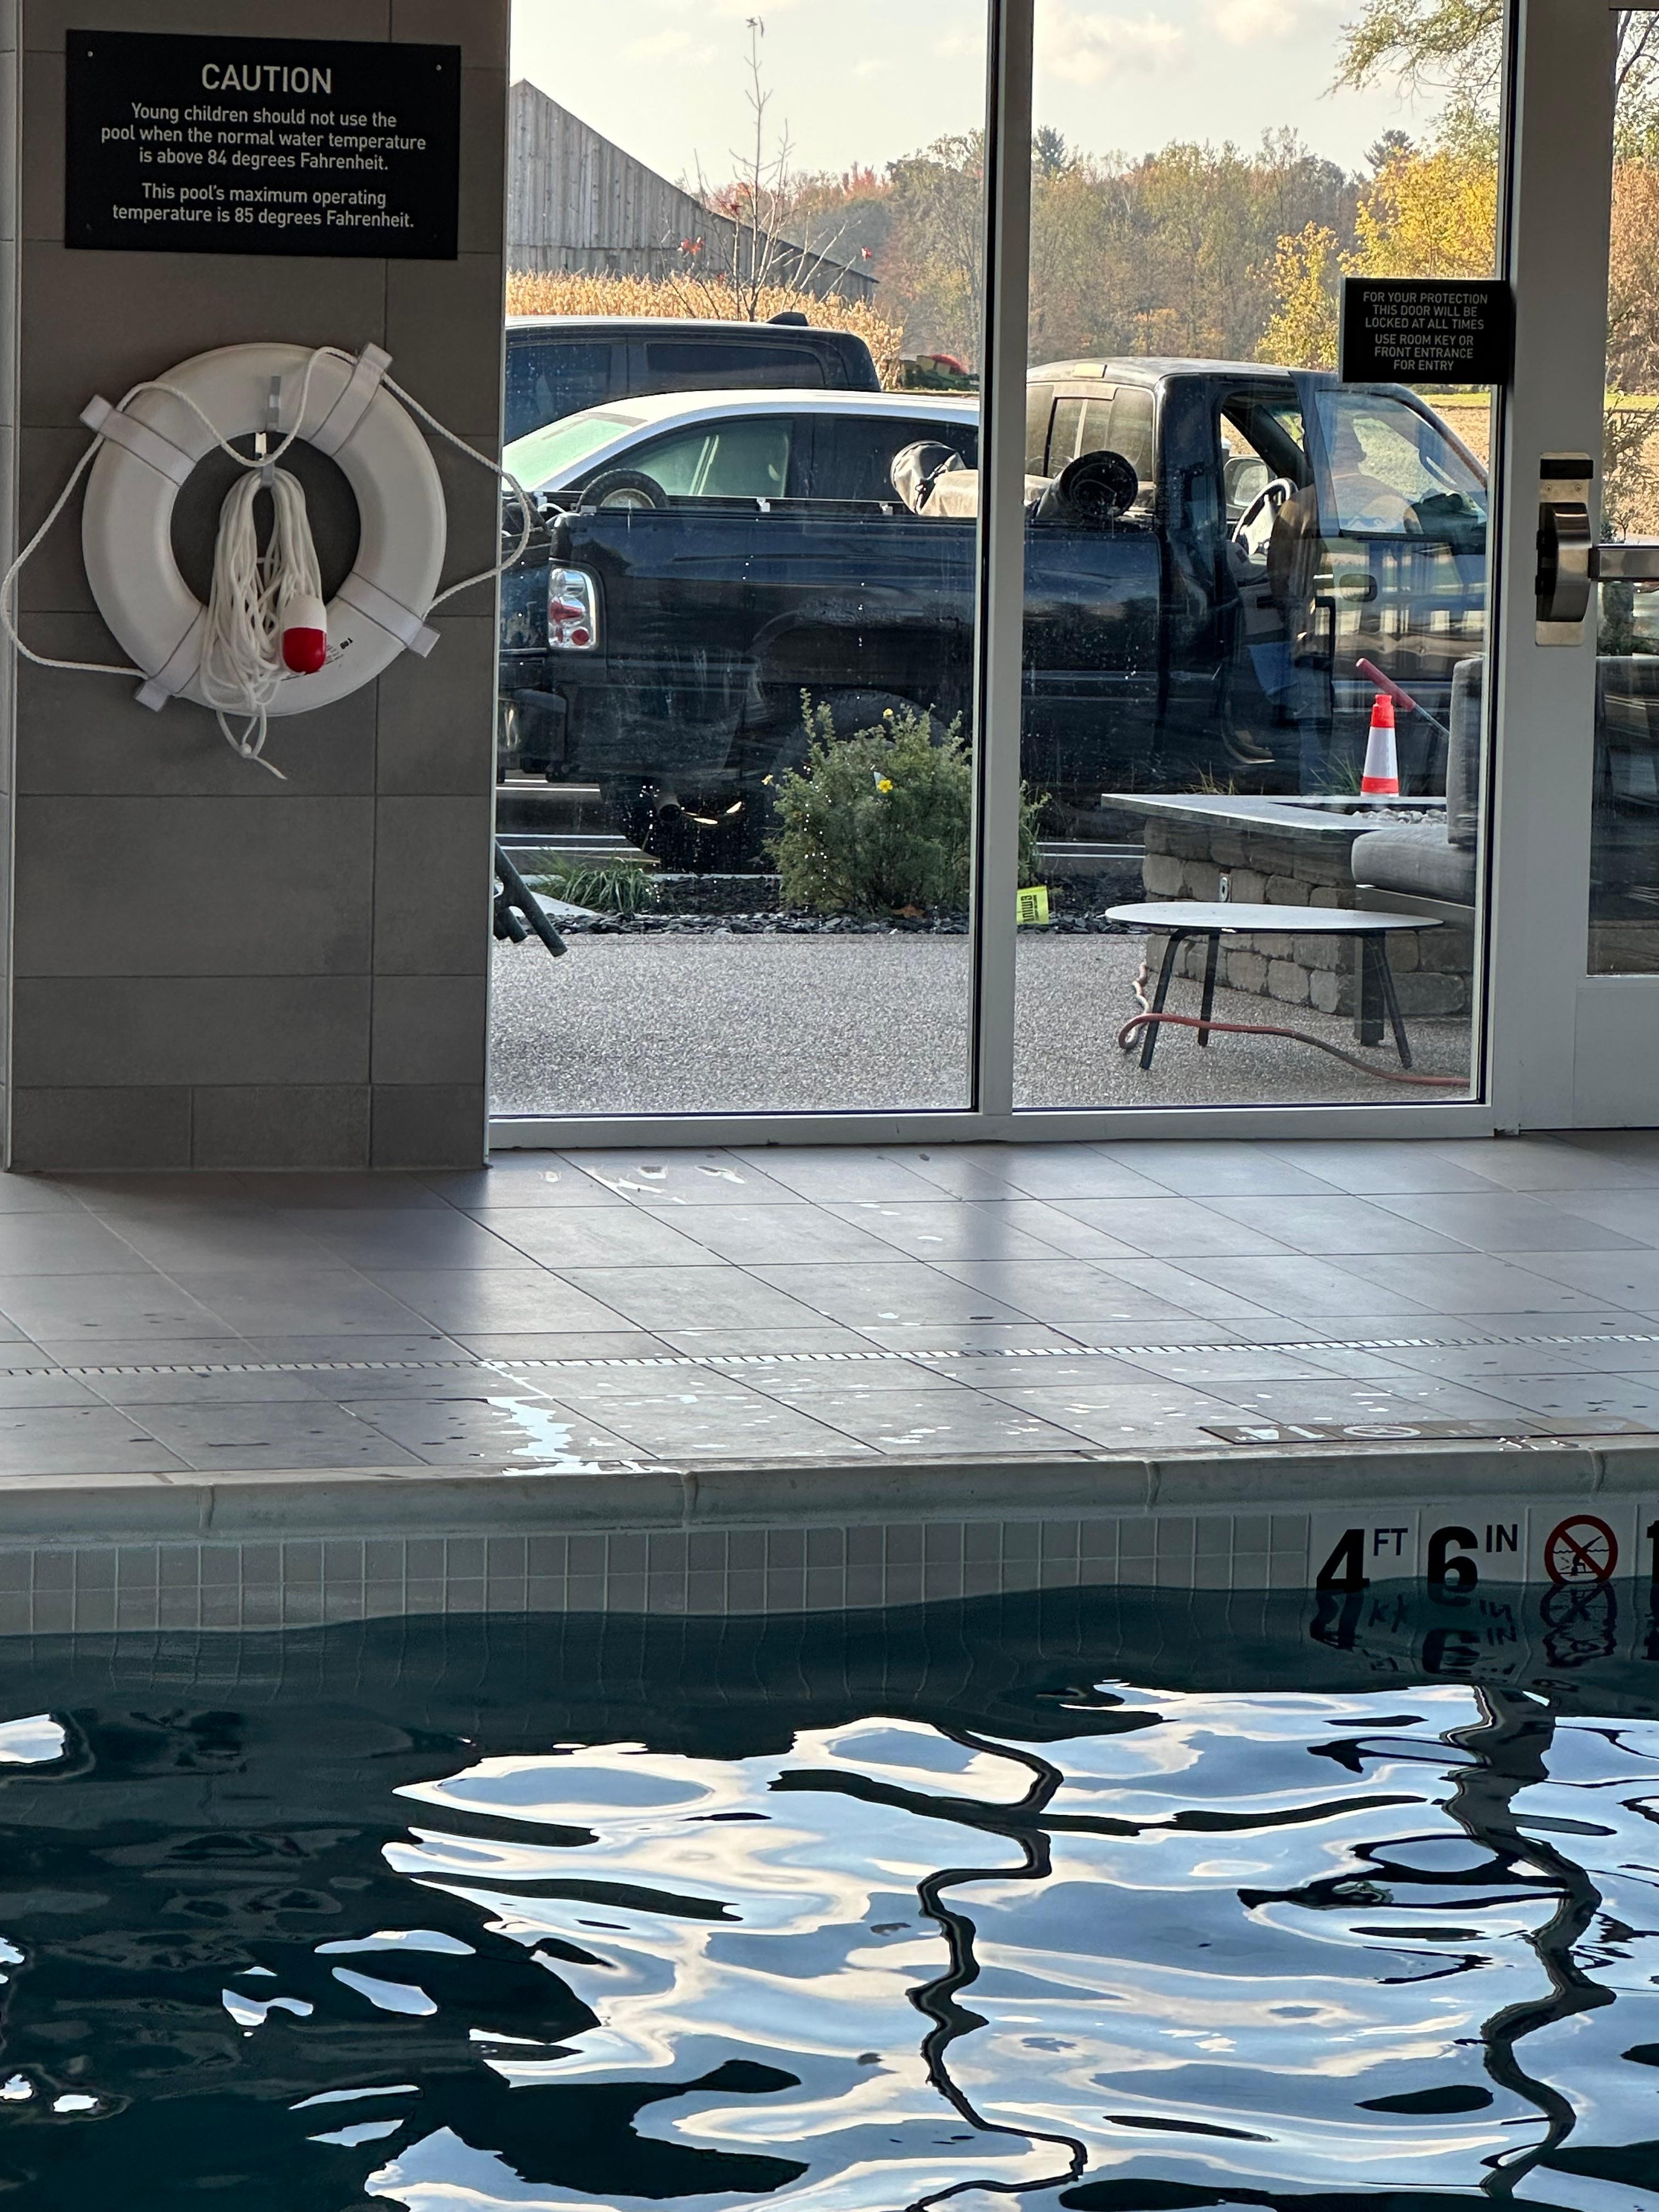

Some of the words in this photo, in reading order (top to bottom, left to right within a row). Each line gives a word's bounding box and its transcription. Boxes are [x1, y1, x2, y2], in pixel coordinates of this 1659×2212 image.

[201, 63, 331, 94] CAUTION
[131, 101, 179, 125] Young
[184, 104, 249, 123] children
[252, 107, 306, 125] should
[310, 111, 335, 126] not
[340, 114, 368, 127] use
[371, 111, 397, 128] the
[101, 124, 136, 144] pool
[139, 125, 183, 142] when
[187, 126, 213, 144] the
[217, 129, 275, 146] normal
[278, 131, 325, 147] water
[328, 132, 427, 153] temperature
[139, 146, 153, 163] is
[156, 147, 204, 165] above
[207, 149, 228, 166] 84
[231, 150, 296, 171] degrees
[300, 151, 388, 171] Fahrenheit.
[141, 182, 176, 199] This
[179, 184, 225, 204] pool's
[229, 186, 308, 204] maximum
[312, 189, 386, 210] operating
[112, 204, 213, 224] temperature
[217, 206, 230, 223] is
[234, 206, 254, 223] 85
[257, 207, 322, 229] degrees
[326, 209, 414, 228] Fahrenheit.
[1363, 292, 1385, 302] FOR
[1388, 292, 1417, 302] YOUR
[1420, 293, 1487, 304] PROTECTION
[1373, 304, 1397, 315] THIS
[1401, 305, 1430, 315] DOOR
[1434, 306, 1460, 316] WILL
[1464, 307, 1477, 317] BE
[1365, 317, 1408, 328] LOCKED
[1412, 318, 1425, 329] AT
[1427, 319, 1448, 329] ALL
[1452, 319, 1483, 329] TIMES
[1375, 334, 1396, 344] USE
[1400, 335, 1431, 345] ROOM
[1435, 335, 1456, 345] KEY
[1459, 335, 1473, 346] OR
[1375, 346, 1411, 357] FRONT
[1414, 347, 1473, 358] ENTRANCE
[1394, 360, 1415, 370] FOR
[1419, 360, 1453, 370] ENTRY
[1316, 1528, 1370, 1593] 4
[1374, 1528, 1408, 1556] FT
[1427, 1526, 1478, 1593] 6
[1486, 1524, 1517, 1552] IN
